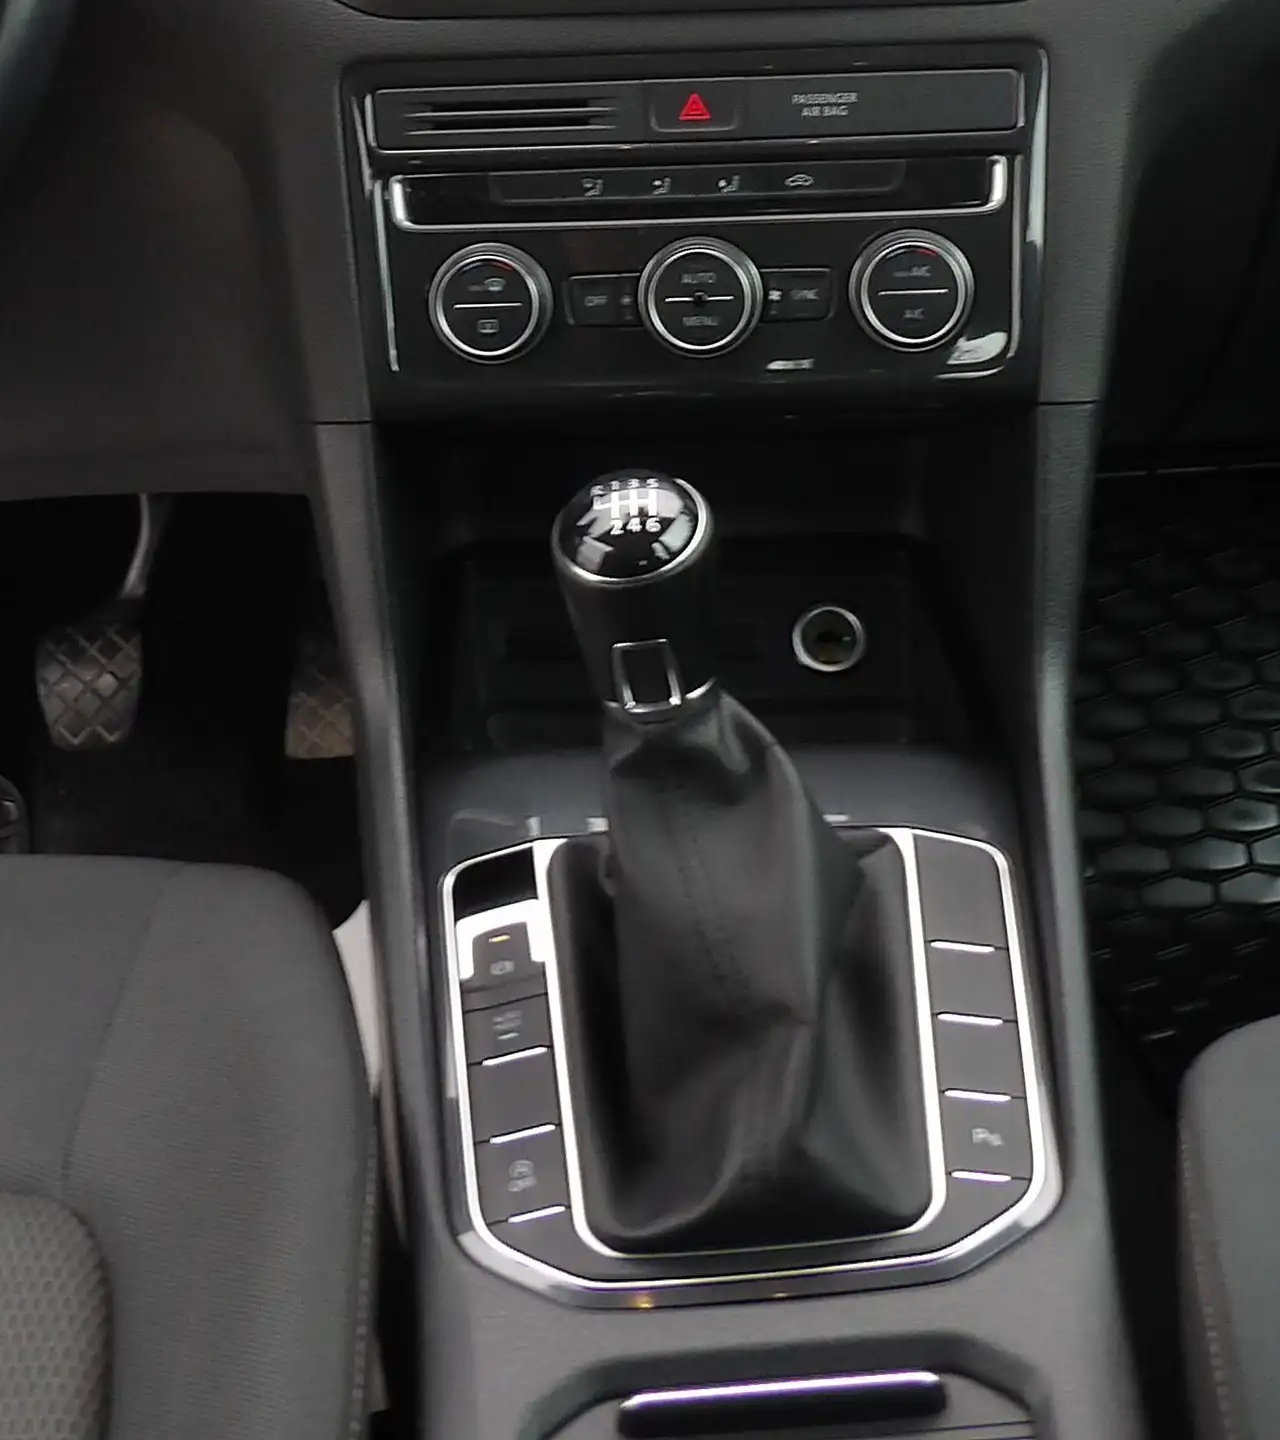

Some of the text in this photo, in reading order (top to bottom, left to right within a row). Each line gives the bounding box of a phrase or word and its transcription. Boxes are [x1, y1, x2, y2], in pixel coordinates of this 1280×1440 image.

[681, 272, 717, 284] AUTO
[585, 295, 608, 307] OFF
[627, 478, 640, 490] 3
[646, 478, 659, 489] 5
[610, 516, 661, 535] 2 4 6
